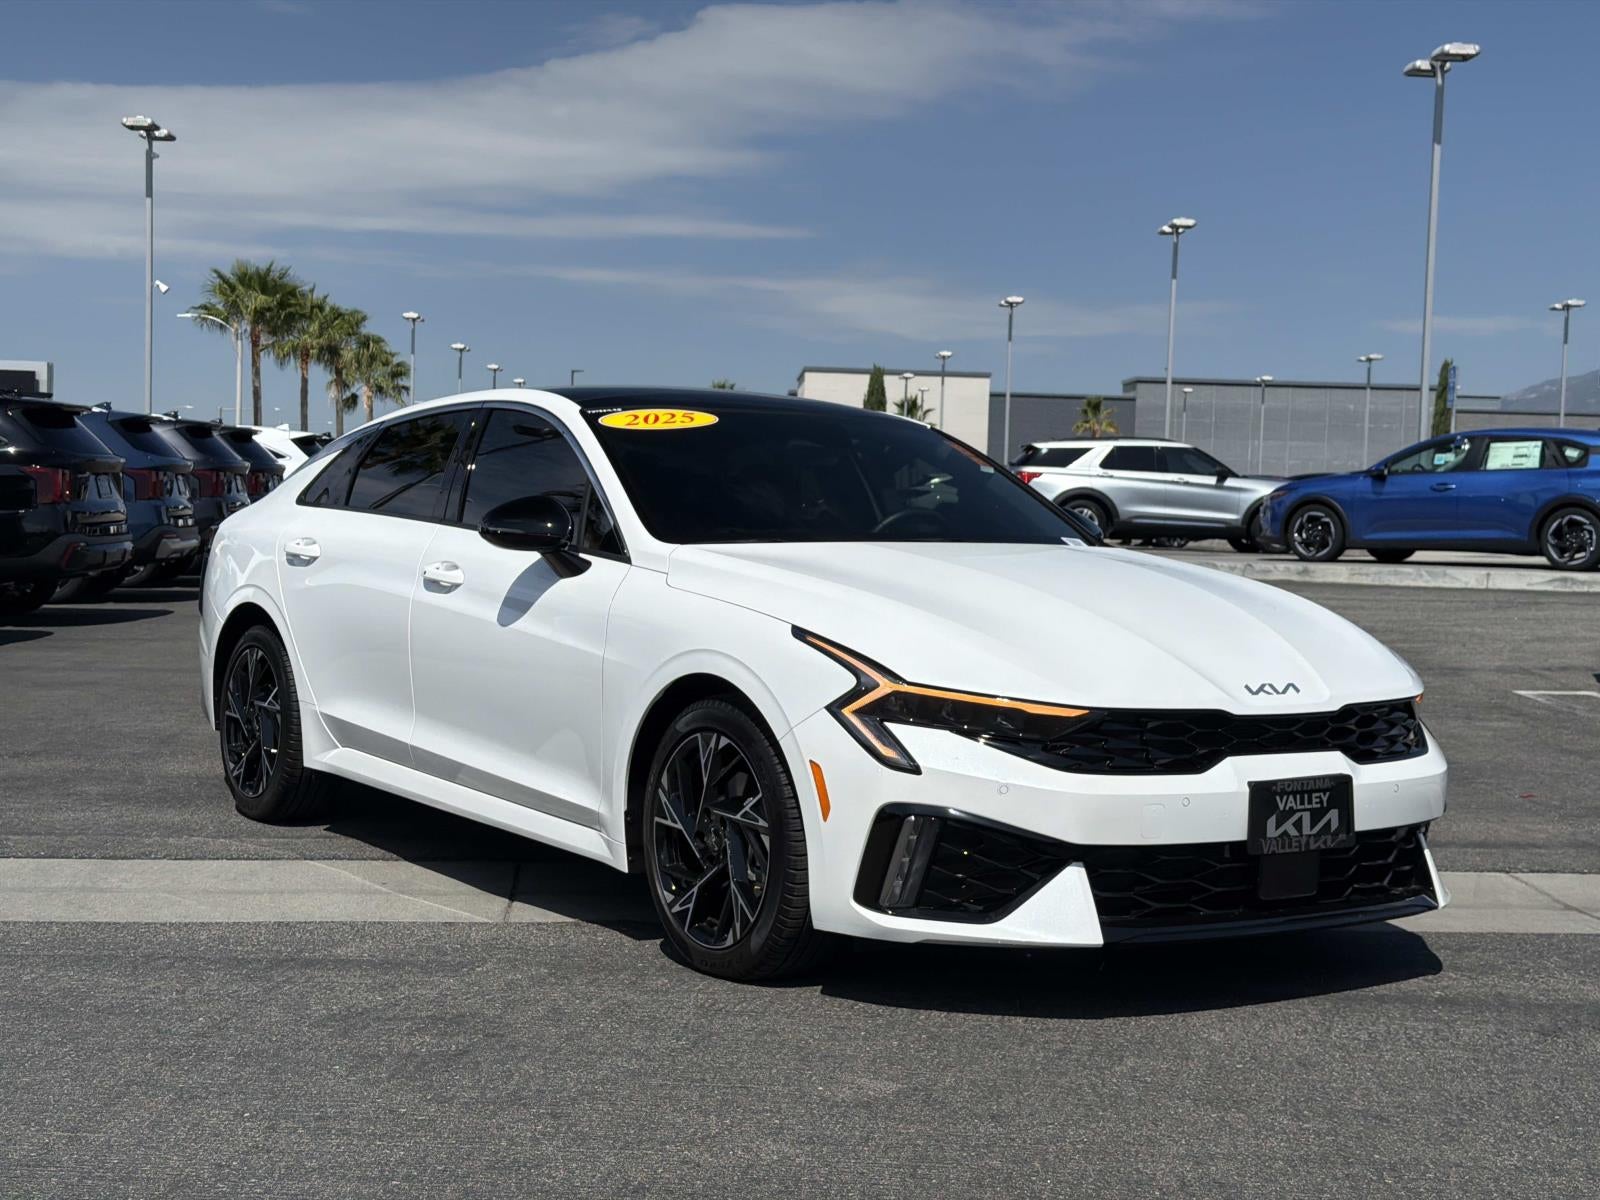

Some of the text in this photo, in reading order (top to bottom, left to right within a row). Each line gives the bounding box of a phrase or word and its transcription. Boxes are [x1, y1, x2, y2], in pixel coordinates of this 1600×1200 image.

[624, 413, 695, 426] 2025
[1244, 683, 1301, 695] KIA
[1276, 792, 1330, 810] VALLEY
[1266, 809, 1340, 838] KIA
[1259, 836, 1306, 854] VALLEY
